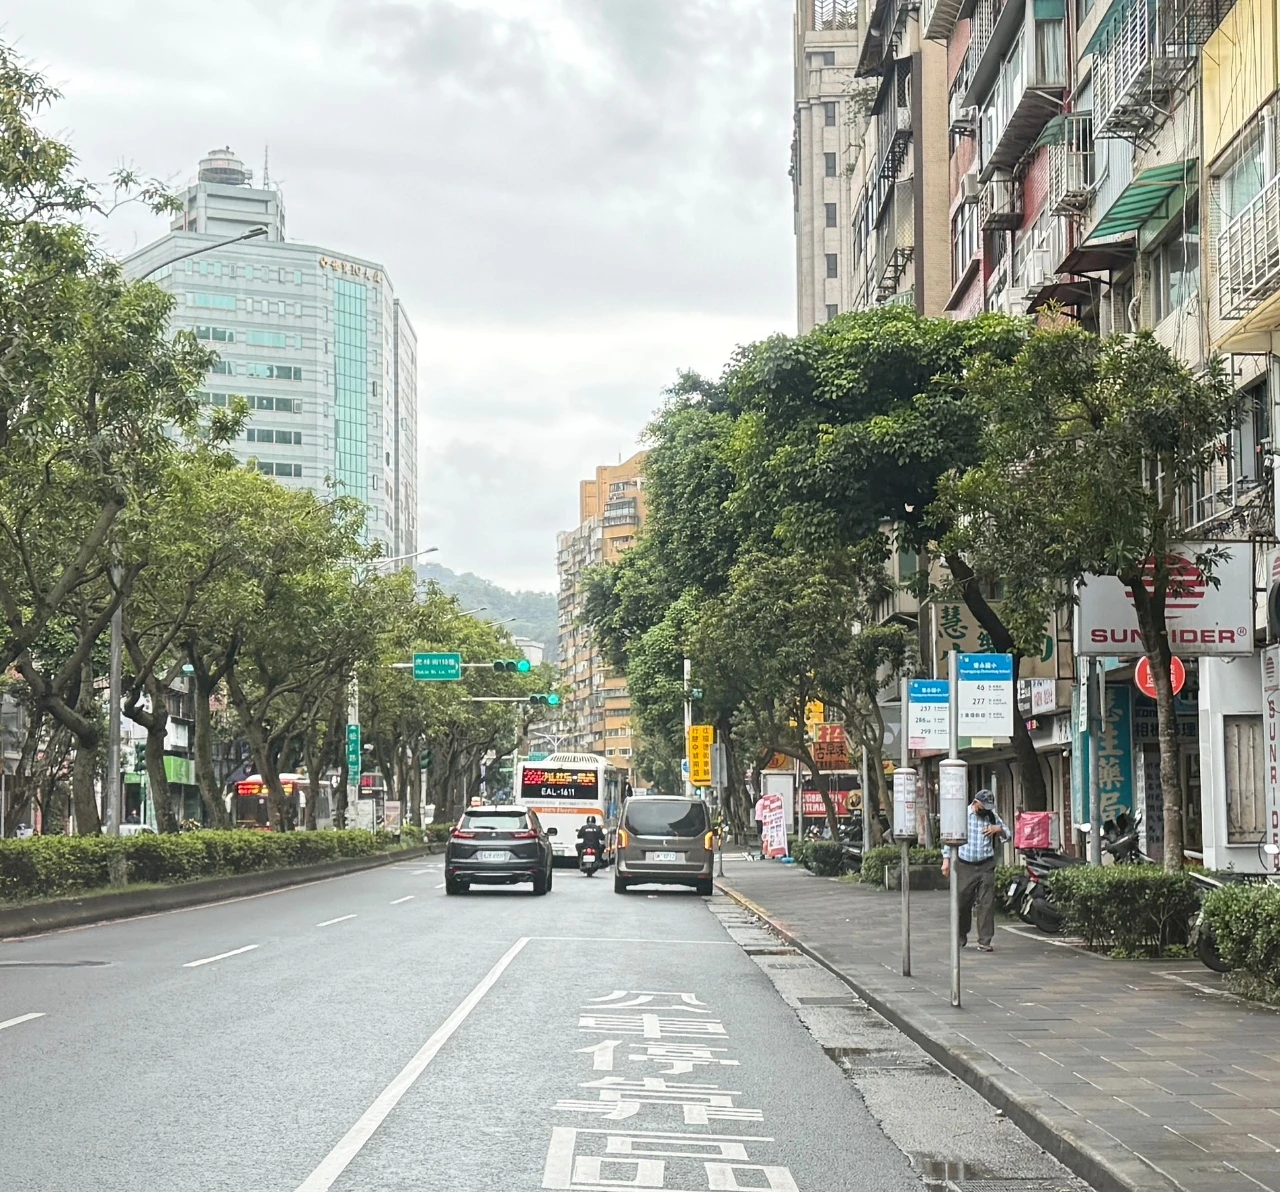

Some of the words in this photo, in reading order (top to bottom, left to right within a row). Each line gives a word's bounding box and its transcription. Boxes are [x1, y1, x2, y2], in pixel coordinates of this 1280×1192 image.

[1091, 629, 1235, 643] SUNIDER
[816, 743, 847, 759] 古早味
[541, 788, 575, 796] EAL-1611
